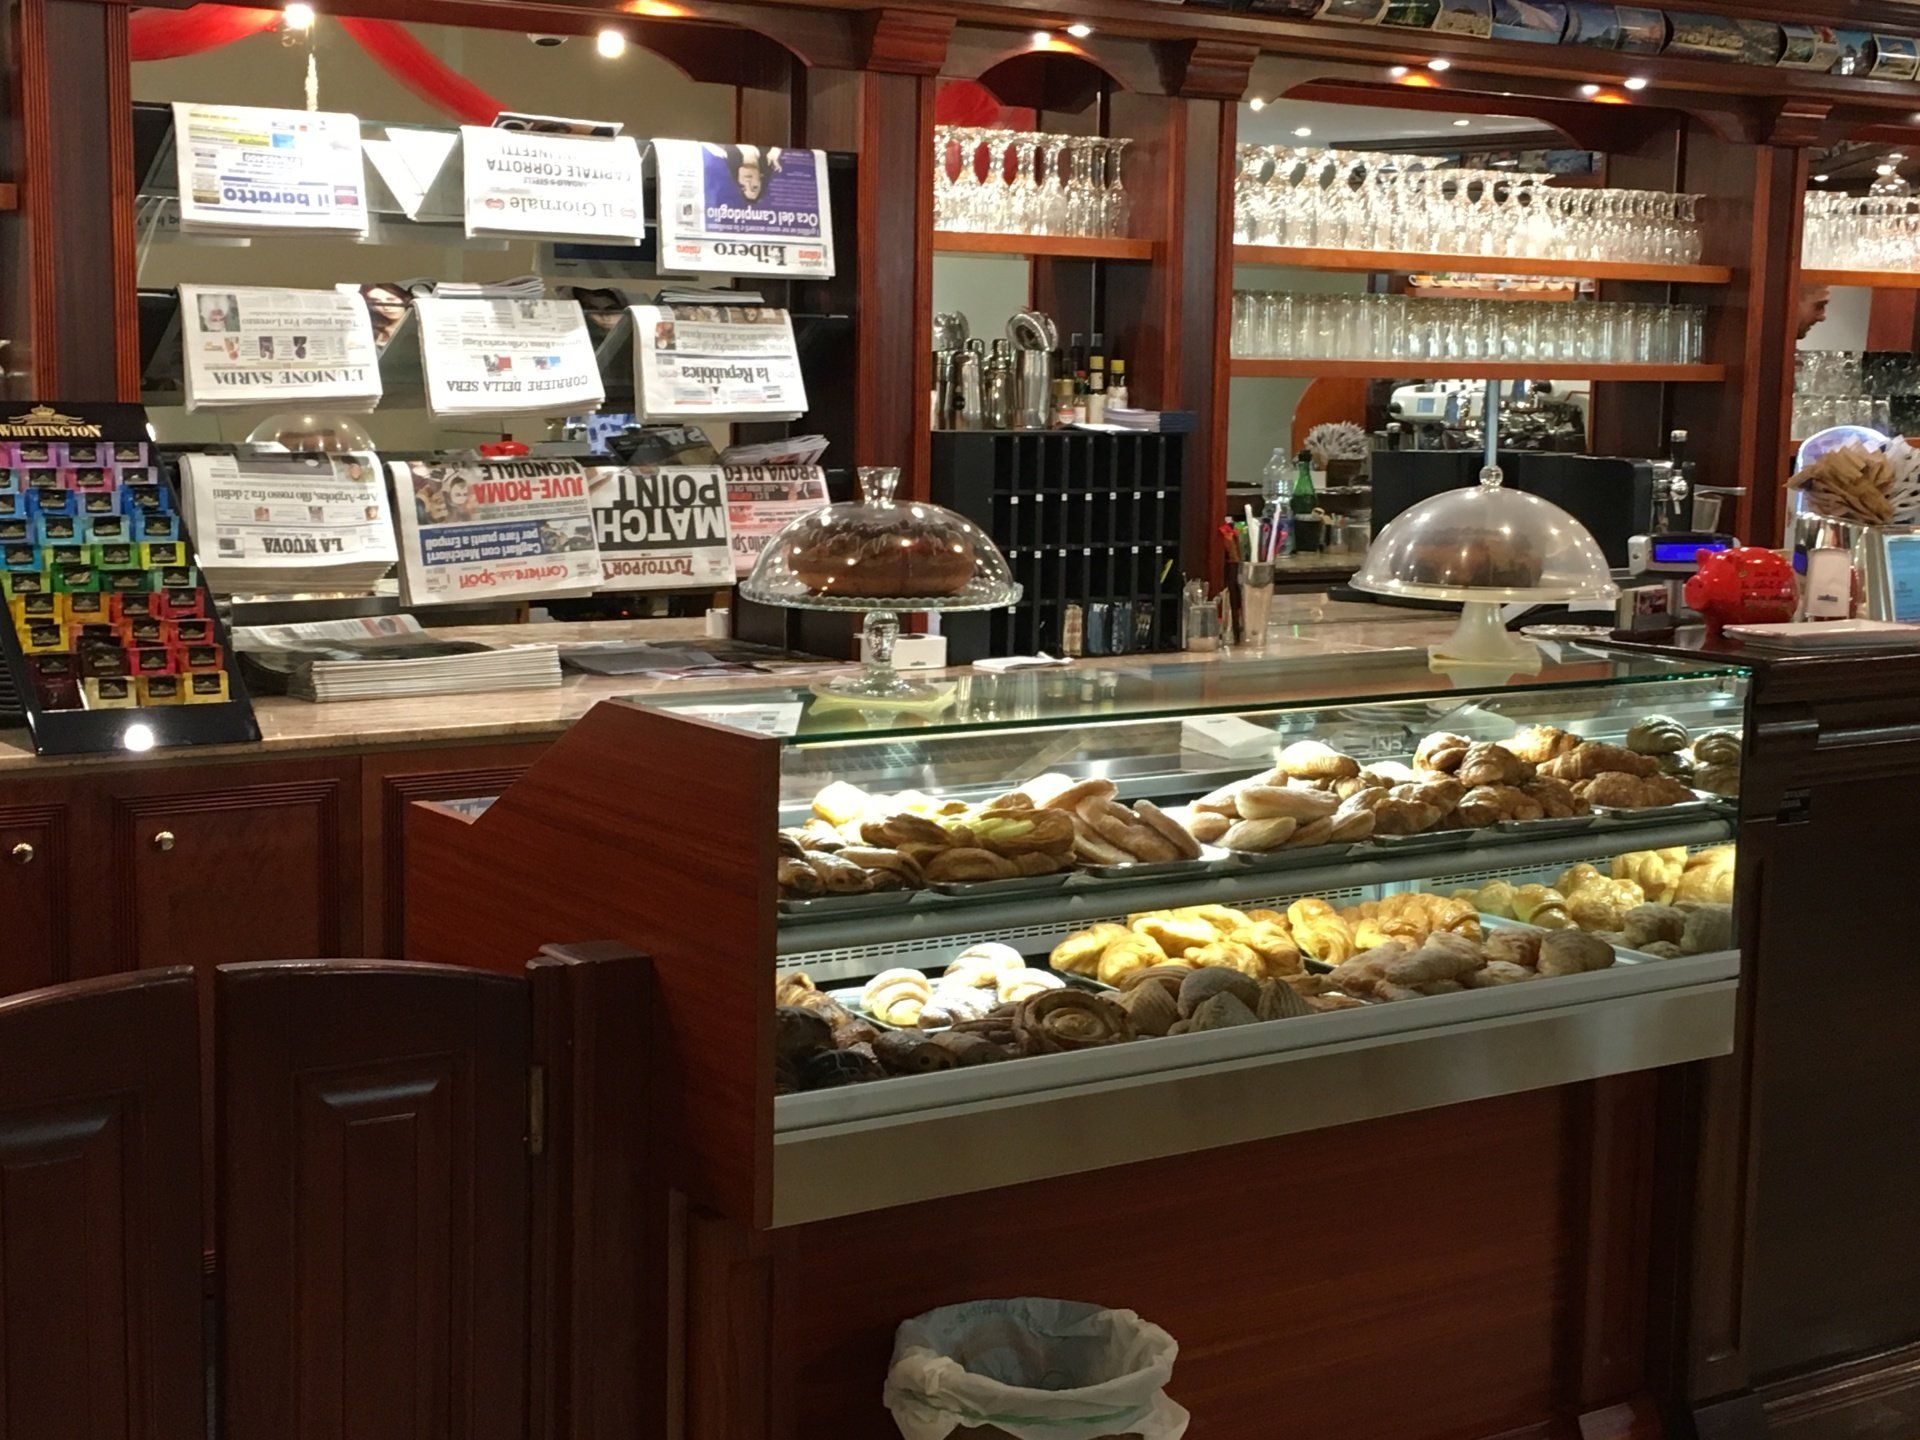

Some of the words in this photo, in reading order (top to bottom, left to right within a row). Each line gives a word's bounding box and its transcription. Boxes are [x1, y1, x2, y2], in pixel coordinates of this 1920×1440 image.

[485, 158, 562, 177] CORROTTA
[223, 187, 310, 206] baratto
[318, 194, 329, 207] il
[509, 197, 596, 217] Giornale
[603, 203, 614, 217] il
[706, 203, 777, 225] Campidoglio
[778, 211, 795, 226] del
[796, 213, 818, 227] Oca
[713, 242, 787, 266] Libero
[212, 371, 272, 386] SARDA
[279, 368, 364, 384] L'UNIONE
[681, 364, 753, 384] Repubblica
[756, 367, 769, 383] la
[446, 380, 479, 392] SERA
[482, 380, 521, 392] DELLA
[527, 374, 588, 391] CORRIERE
[0, 423, 102, 438] WHITTINGTON
[478, 460, 581, 480] MONDIALE
[745, 466, 761, 481] DI
[765, 465, 819, 482] PROVA
[212, 489, 242, 501] delitti
[243, 490, 250, 500] 2
[251, 490, 267, 501] fra
[267, 491, 294, 499] rosso
[295, 491, 312, 503] filo
[471, 476, 584, 504] JUVE-ROMA
[612, 475, 721, 506] POINT
[597, 506, 726, 543] MATCH
[462, 536, 470, 545] a
[470, 531, 498, 547] punti
[498, 532, 521, 544] fare
[520, 528, 539, 540] per
[261, 537, 318, 553] NUOVA
[320, 537, 343, 553] LA
[424, 535, 462, 551] Empoli
[502, 541, 542, 557] Cagliari
[426, 548, 481, 564] Melchiorri
[481, 547, 501, 557] con
[514, 565, 568, 581] Corriere
[601, 558, 694, 580] TUTTOSPORT
